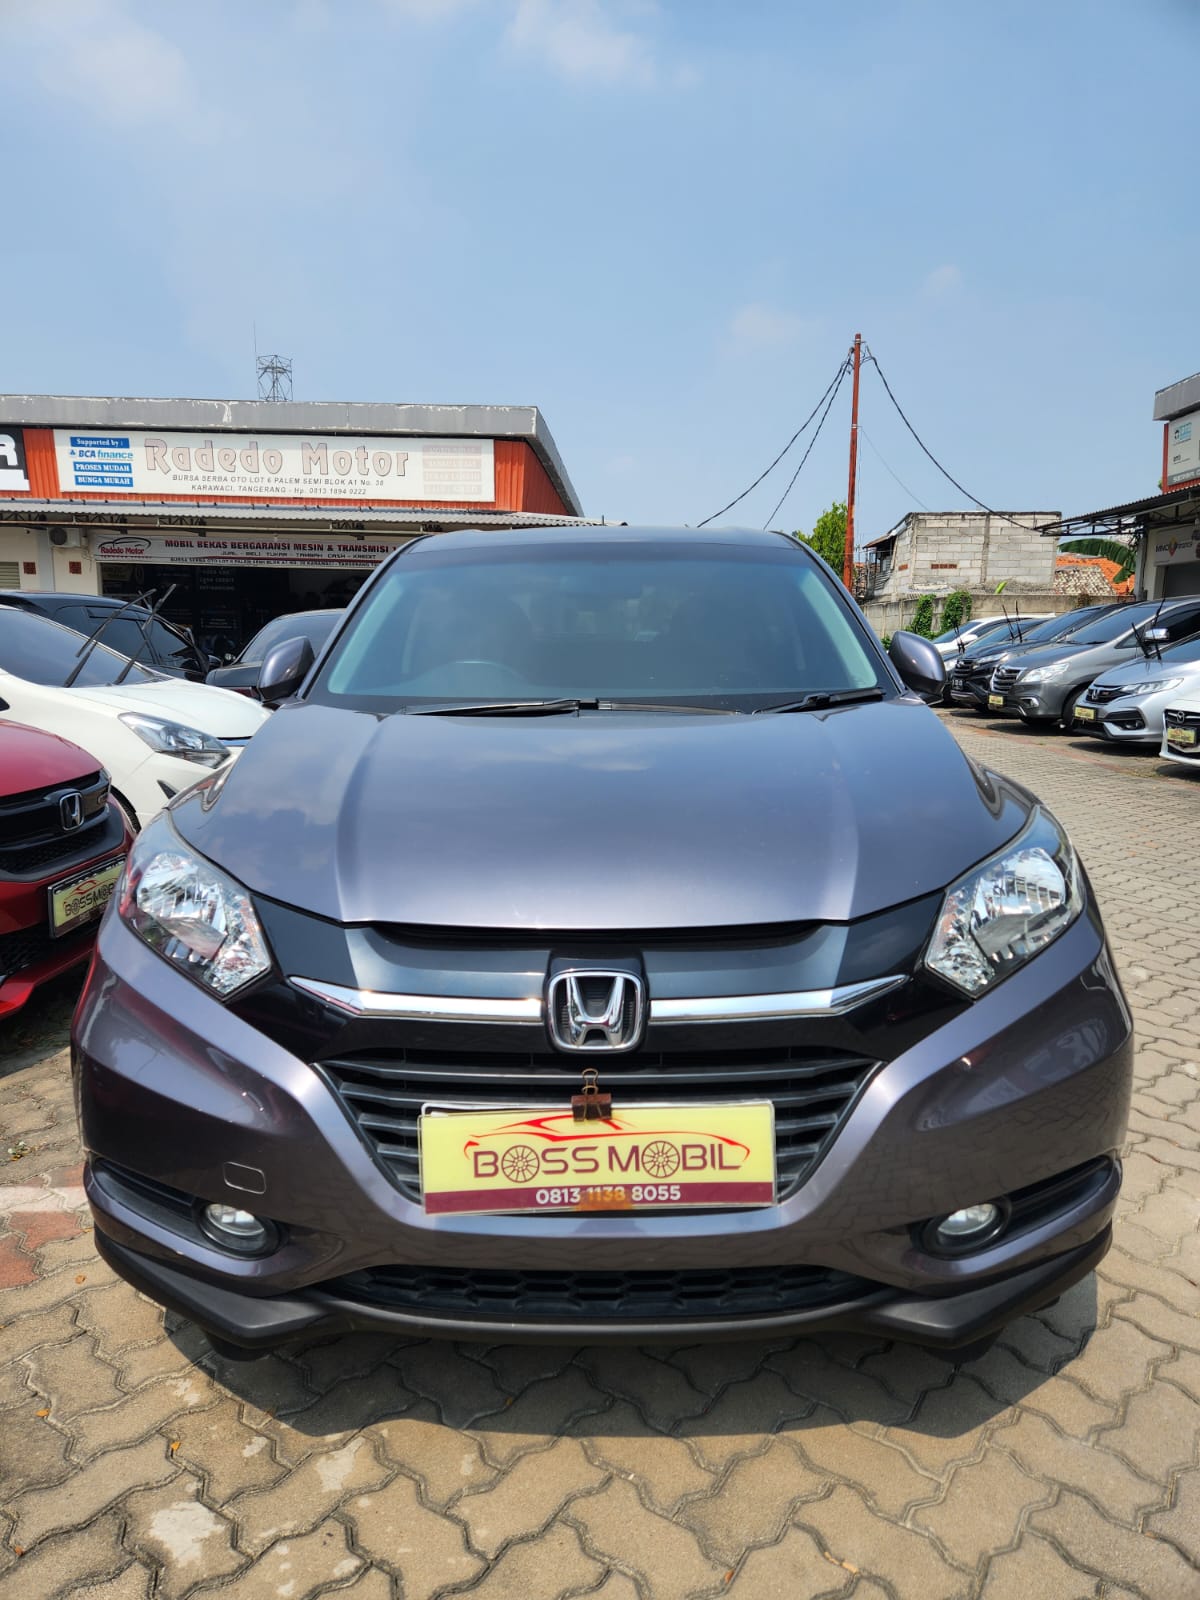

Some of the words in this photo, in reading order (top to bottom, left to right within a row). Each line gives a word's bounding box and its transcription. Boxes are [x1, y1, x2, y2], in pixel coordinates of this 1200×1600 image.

[76, 438, 110, 447] Supported
[111, 439, 119, 448] by
[78, 449, 96, 458] BCA
[98, 449, 134, 459] finance
[144, 438, 283, 475] Radedo
[301, 442, 409, 477] Motor
[76, 463, 102, 472] PROSES
[102, 464, 130, 472] MUDAH
[172, 474, 200, 482] BURSA
[202, 475, 228, 483] SERBA
[191, 484, 235, 492] KARAWACI,
[238, 486, 287, 494] TANGERANG
[125, 547, 145, 555] Motor
[164, 540, 194, 548] MOBIL
[197, 540, 228, 549] BEKAS
[230, 542, 291, 550] BERGARANSI
[293, 543, 324, 552] MESIN
[338, 544, 389, 553] TRANSMISI
[535, 1187, 581, 1204] 0813
[631, 1184, 682, 1202] 8055
